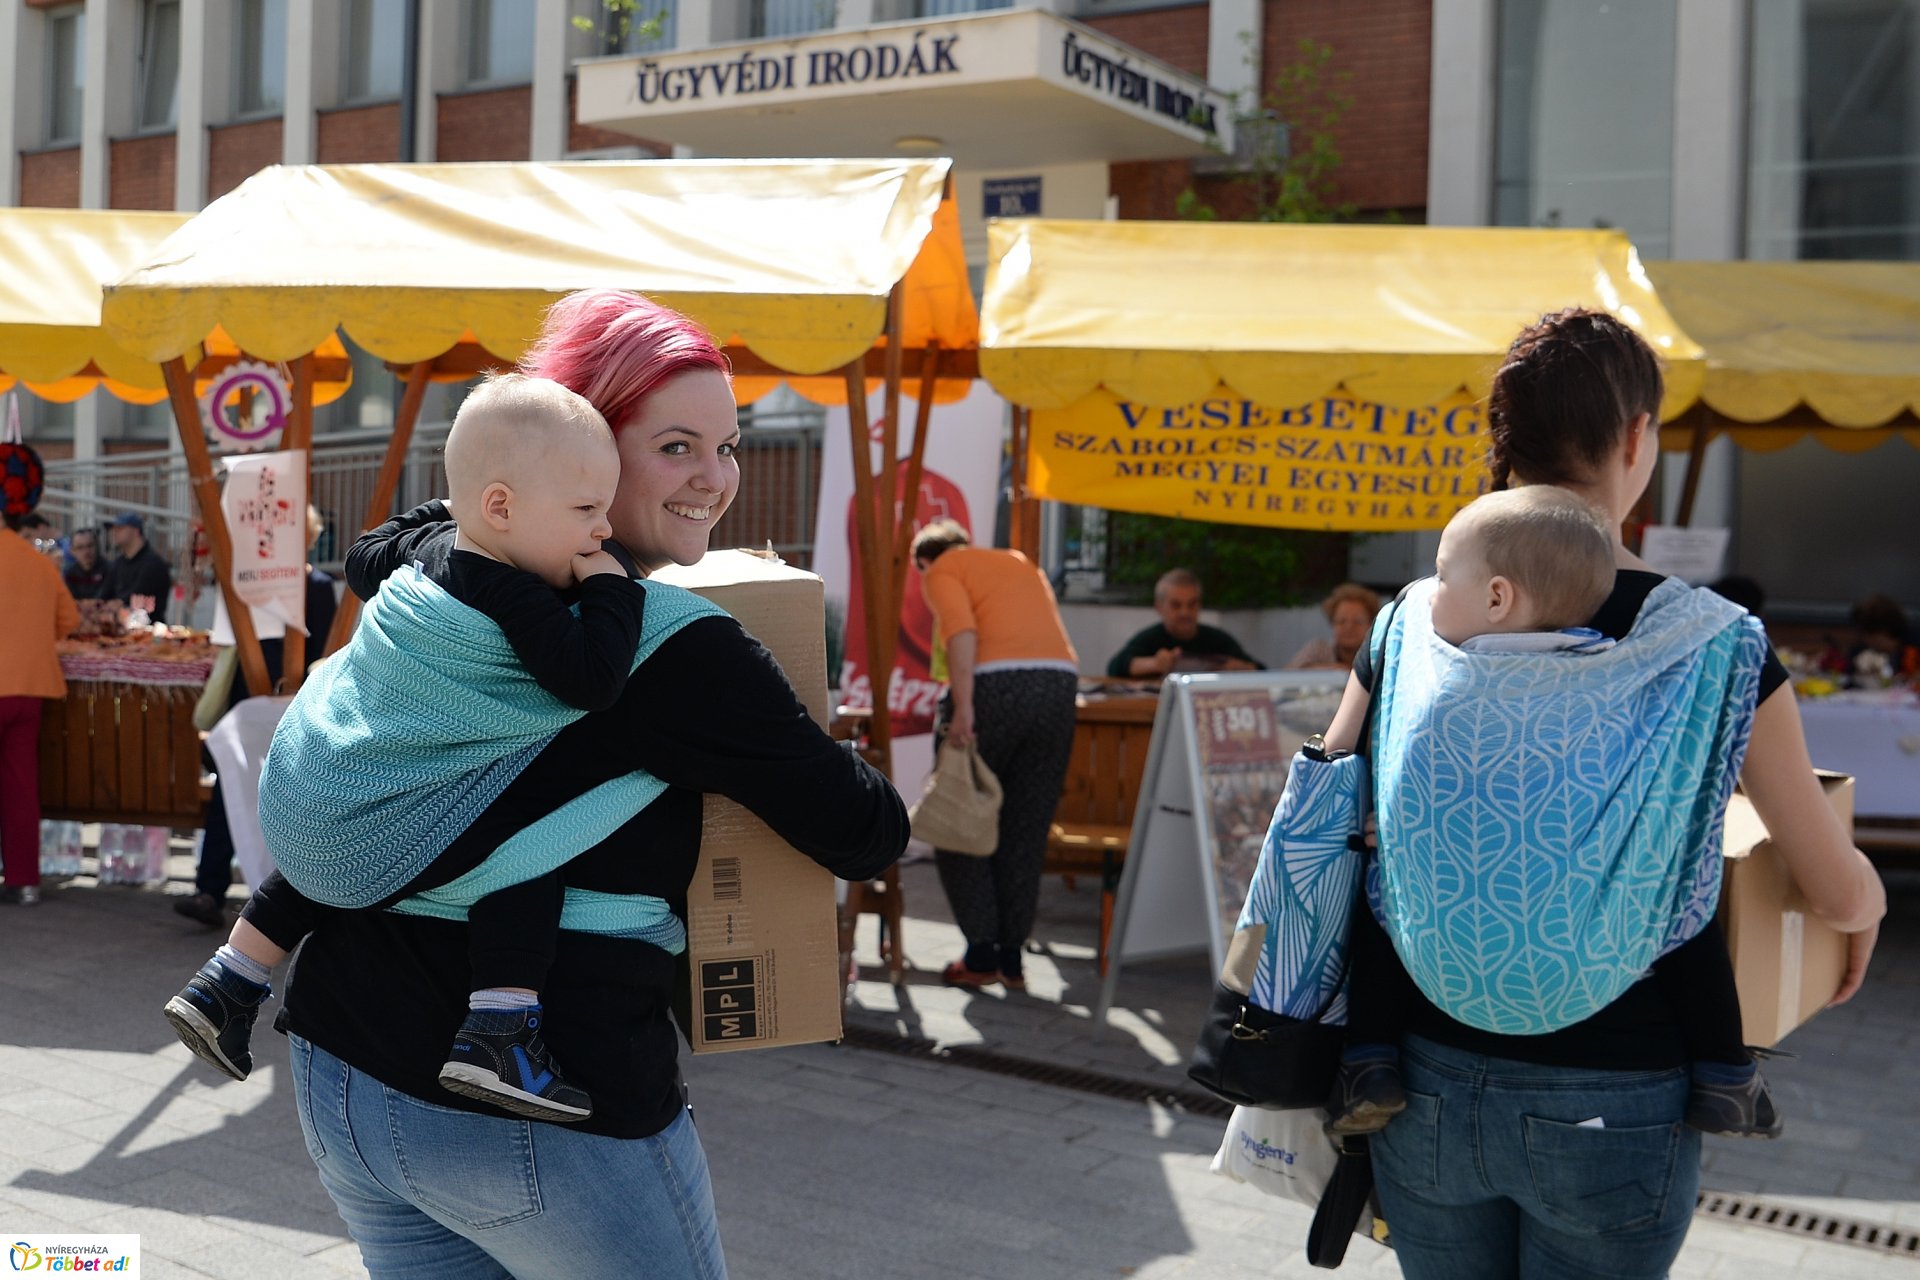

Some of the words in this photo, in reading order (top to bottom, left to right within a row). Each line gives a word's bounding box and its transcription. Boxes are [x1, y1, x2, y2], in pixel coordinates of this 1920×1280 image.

[638, 53, 796, 103] ÜGYVÉDI
[807, 30, 959, 87] IRODÁK
[1054, 431, 1493, 468] SZABOLCS-SZATMÁR-
[1115, 460, 1270, 487] MEGYEI
[1193, 490, 1464, 519] NYÍREGYHÁZ
[719, 966, 741, 1038] MPL
